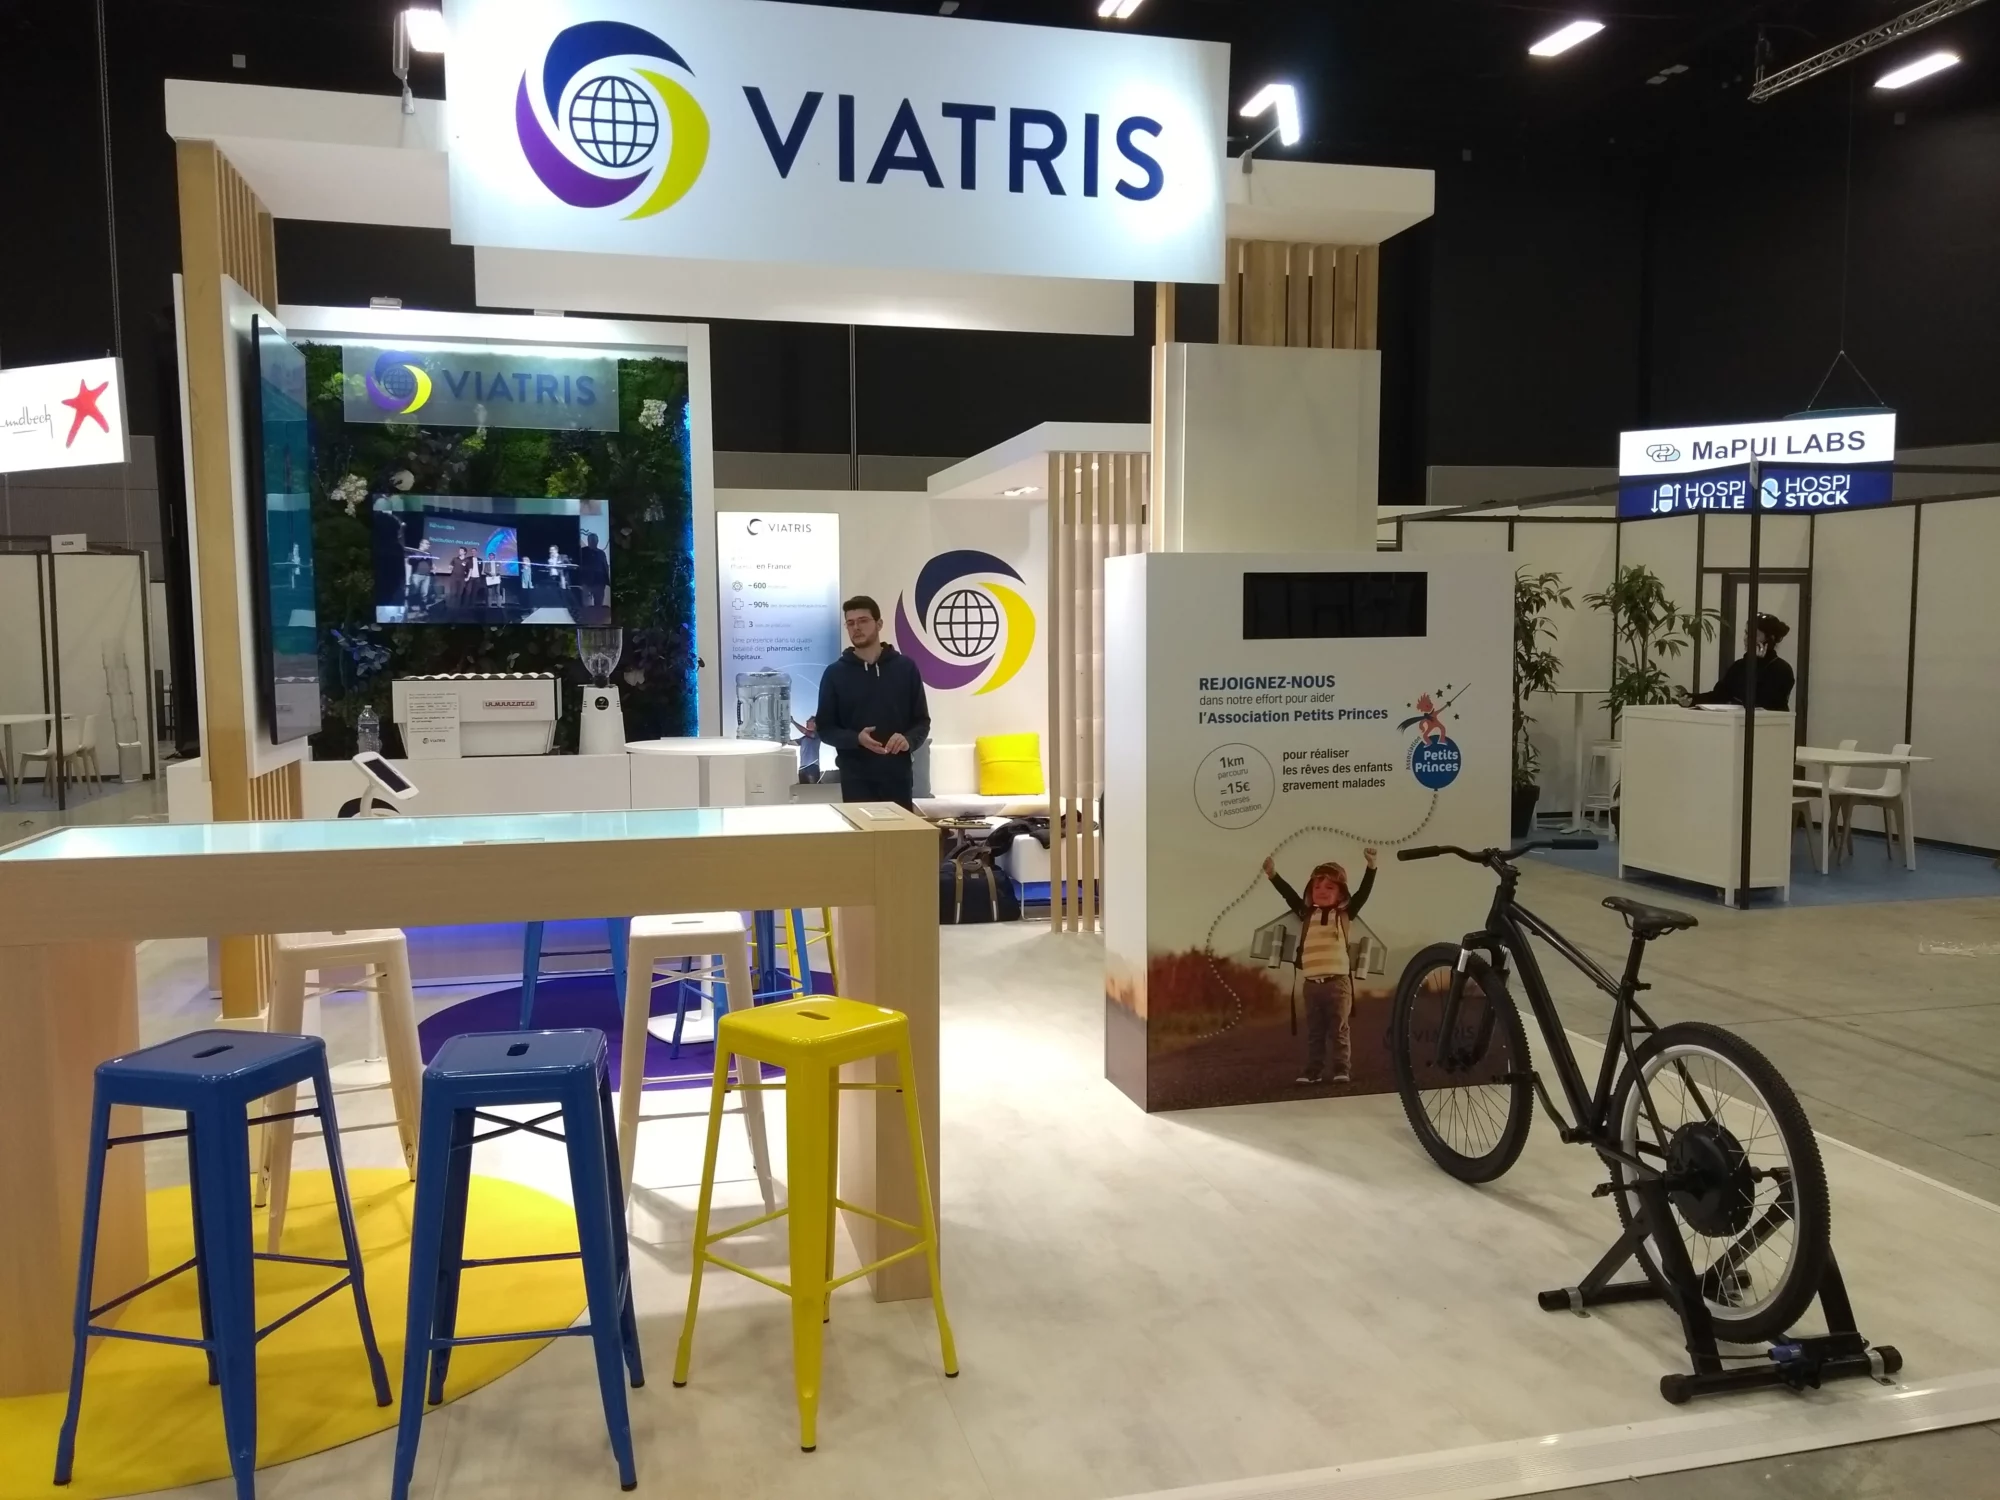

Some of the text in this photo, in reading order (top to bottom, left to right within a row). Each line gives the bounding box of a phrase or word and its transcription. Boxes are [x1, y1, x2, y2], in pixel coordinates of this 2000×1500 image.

[742, 86, 1164, 201] VIATRIS
[442, 370, 597, 406] VIATRIS
[1692, 430, 1866, 460] MaPUI LABS
[1685, 480, 1746, 497] HOSPI
[1785, 474, 1850, 492] HOSPI
[1685, 495, 1745, 509] VILLE
[1785, 490, 1849, 507] STOCK
[768, 523, 812, 533] VIATRIS
[745, 637, 773, 645] présence
[766, 645, 803, 653] pharmacies
[1199, 675, 1336, 691] REJOIGNEZ-NOUS
[1200, 692, 1335, 706] dans notre effort pour aider
[1294, 708, 1334, 722] Petits
[1338, 708, 1389, 720] Princes
[1283, 748, 1350, 762] pour réaliser
[1405, 736, 1422, 770] Association
[1423, 749, 1459, 761] Petits
[1219, 756, 1245, 768] 1km
[1283, 762, 1393, 775] les rêves des enfants
[1415, 761, 1459, 773] Princes
[1217, 768, 1249, 780] parcouru
[1282, 777, 1386, 793] gravement malades
